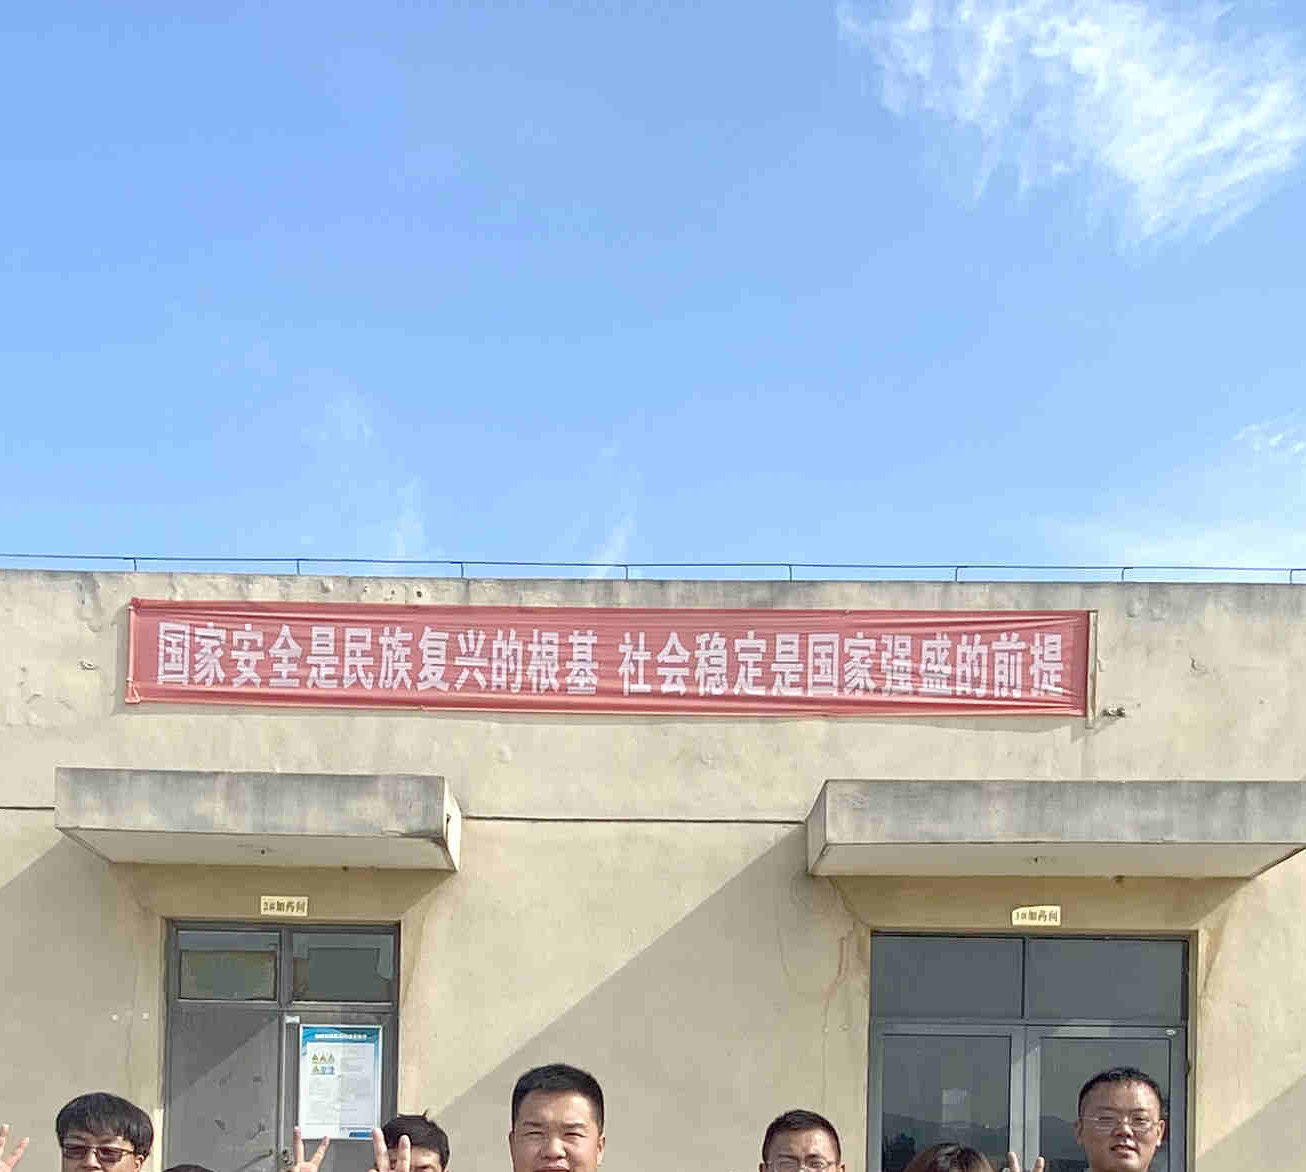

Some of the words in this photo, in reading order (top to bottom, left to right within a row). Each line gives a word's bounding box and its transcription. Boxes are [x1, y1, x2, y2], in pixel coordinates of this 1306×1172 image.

[156, 621, 598, 695] 国家安全是民族复兴的根基
[618, 630, 1063, 697] 社会稳定是国家强盛的前提
